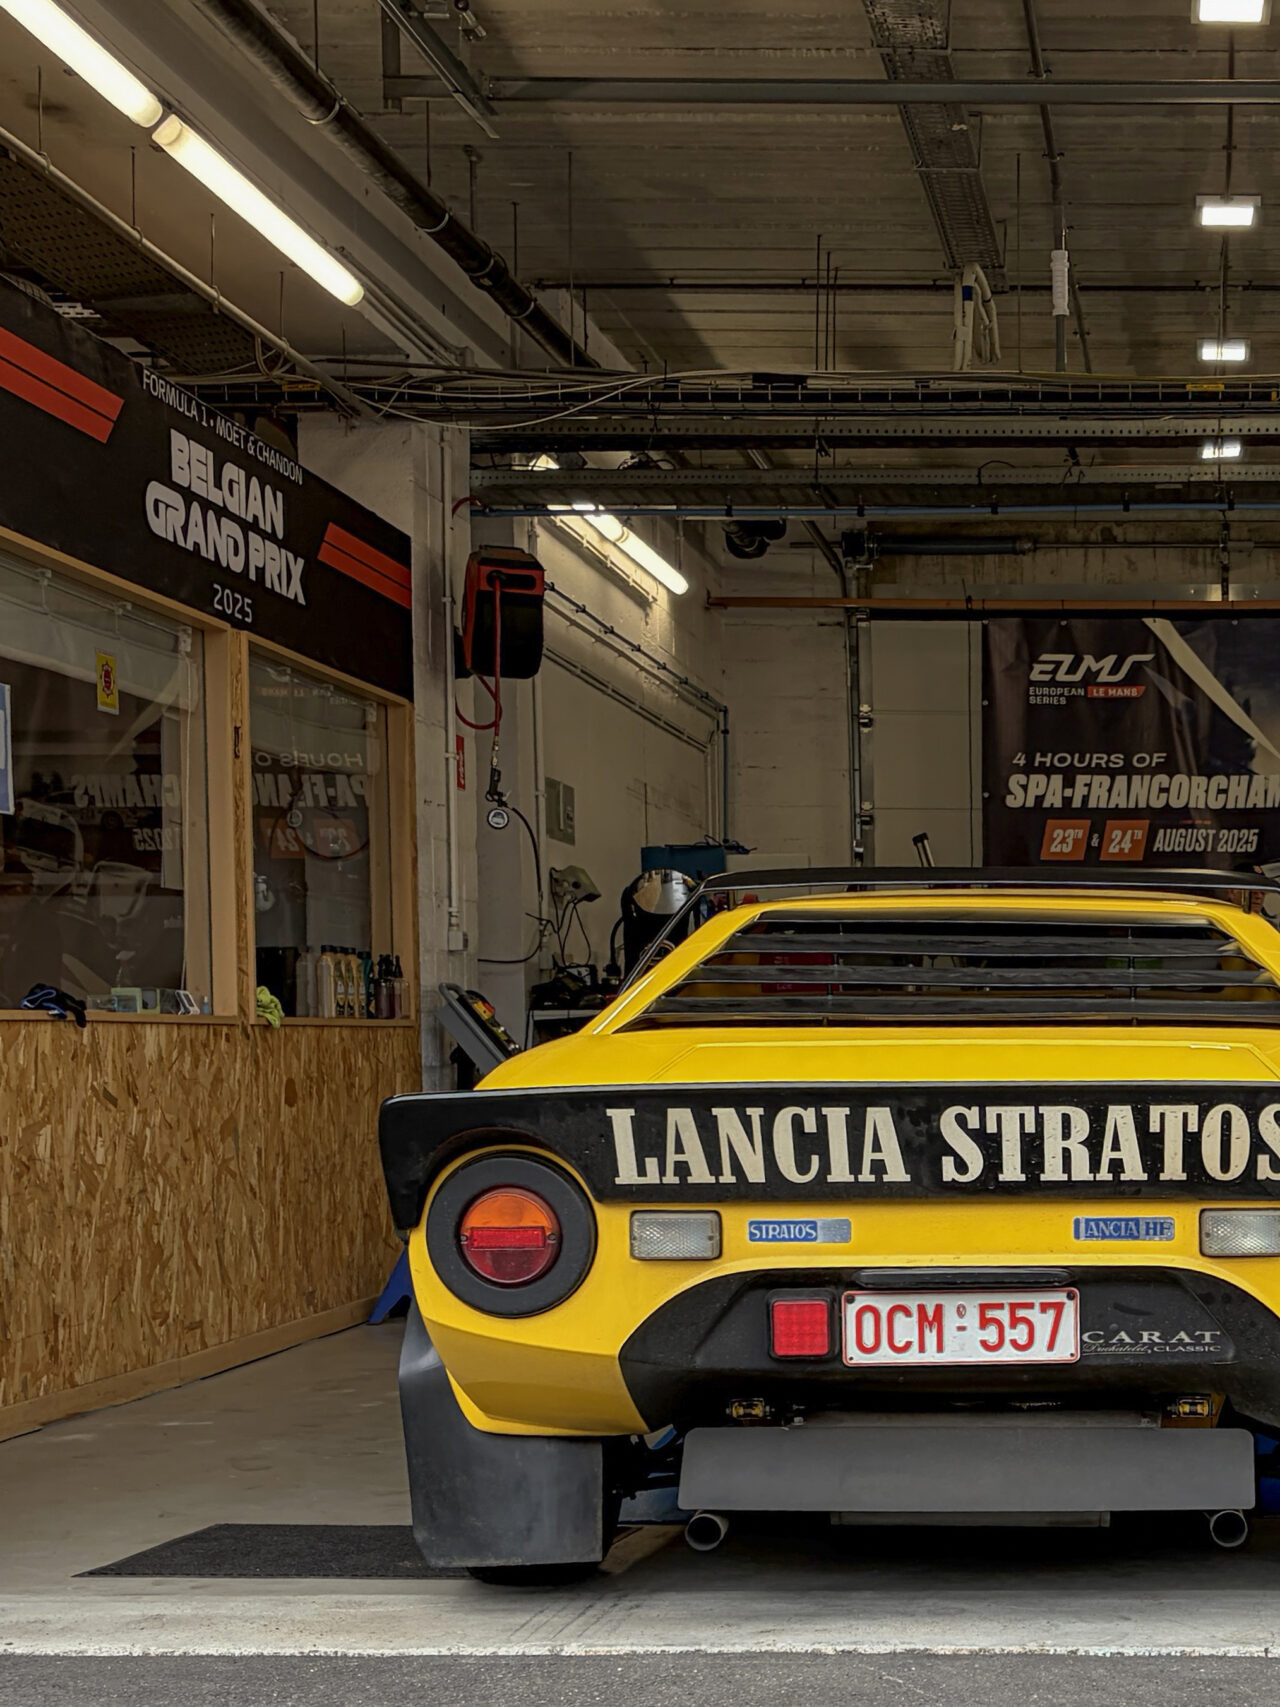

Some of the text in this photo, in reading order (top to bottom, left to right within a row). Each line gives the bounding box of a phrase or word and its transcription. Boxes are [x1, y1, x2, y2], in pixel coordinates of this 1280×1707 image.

[143, 368, 199, 422] FORMULA
[201, 406, 208, 427] 1
[248, 436, 256, 456] &
[256, 441, 303, 486] CHANDON
[170, 428, 284, 540] BELGIAN
[145, 480, 306, 606] GRAND PRIX
[213, 583, 253, 624] 2025
[1029, 653, 1156, 682] ELMS
[1028, 686, 1138, 697] EUROPEAN LE MANS
[1028, 695, 1067, 705] SERIES
[1012, 752, 1168, 768] 4 HOURS OF
[1091, 833, 1100, 848] &
[1153, 828, 1215, 853] AUGUST
[1217, 828, 1259, 853] 2025
[606, 1105, 911, 1186] LANCIA
[1145, 1221, 1174, 1237] HF
[1081, 1330, 1221, 1344] CARAT
[1153, 1345, 1222, 1353] CLASSIC
